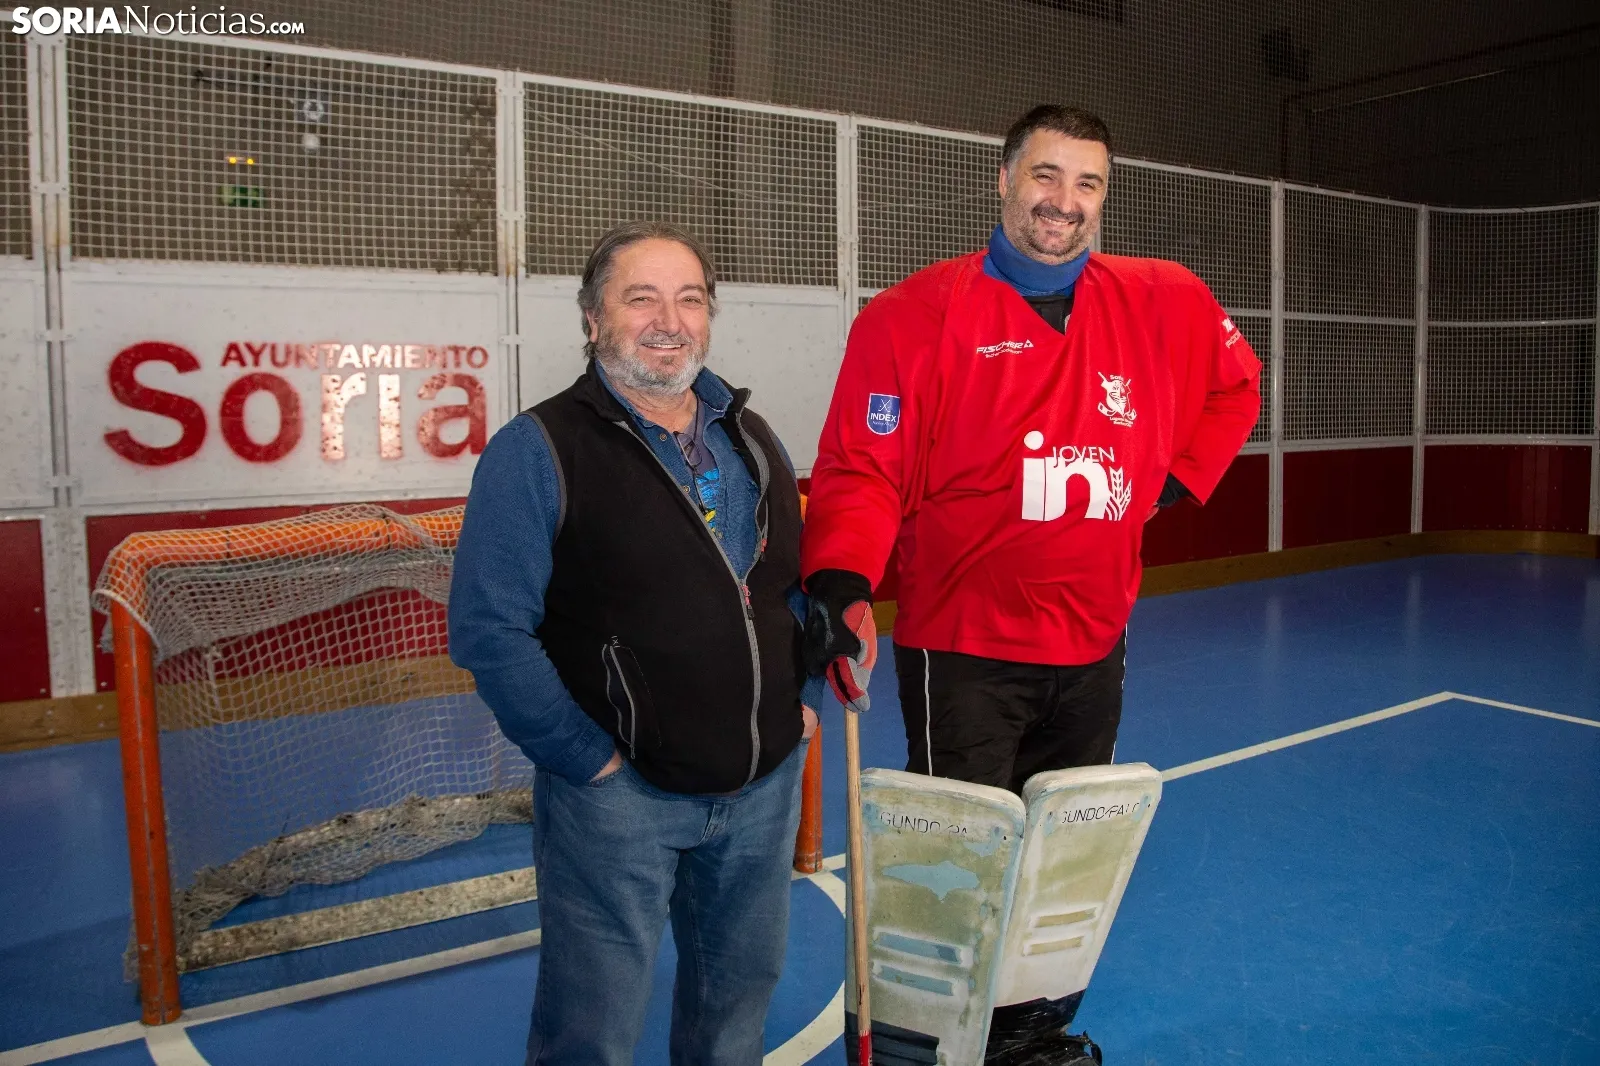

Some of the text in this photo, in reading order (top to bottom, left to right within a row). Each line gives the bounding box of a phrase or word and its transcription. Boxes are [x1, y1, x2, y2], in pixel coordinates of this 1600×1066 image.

[220, 342, 489, 369] AYUNTAMIENTO
[976, 341, 1024, 354] FISCHER
[103, 340, 488, 466] Soria
[870, 412, 897, 422] INDEX
[1052, 445, 1115, 468] JOVEN
[1021, 430, 1110, 522] in
